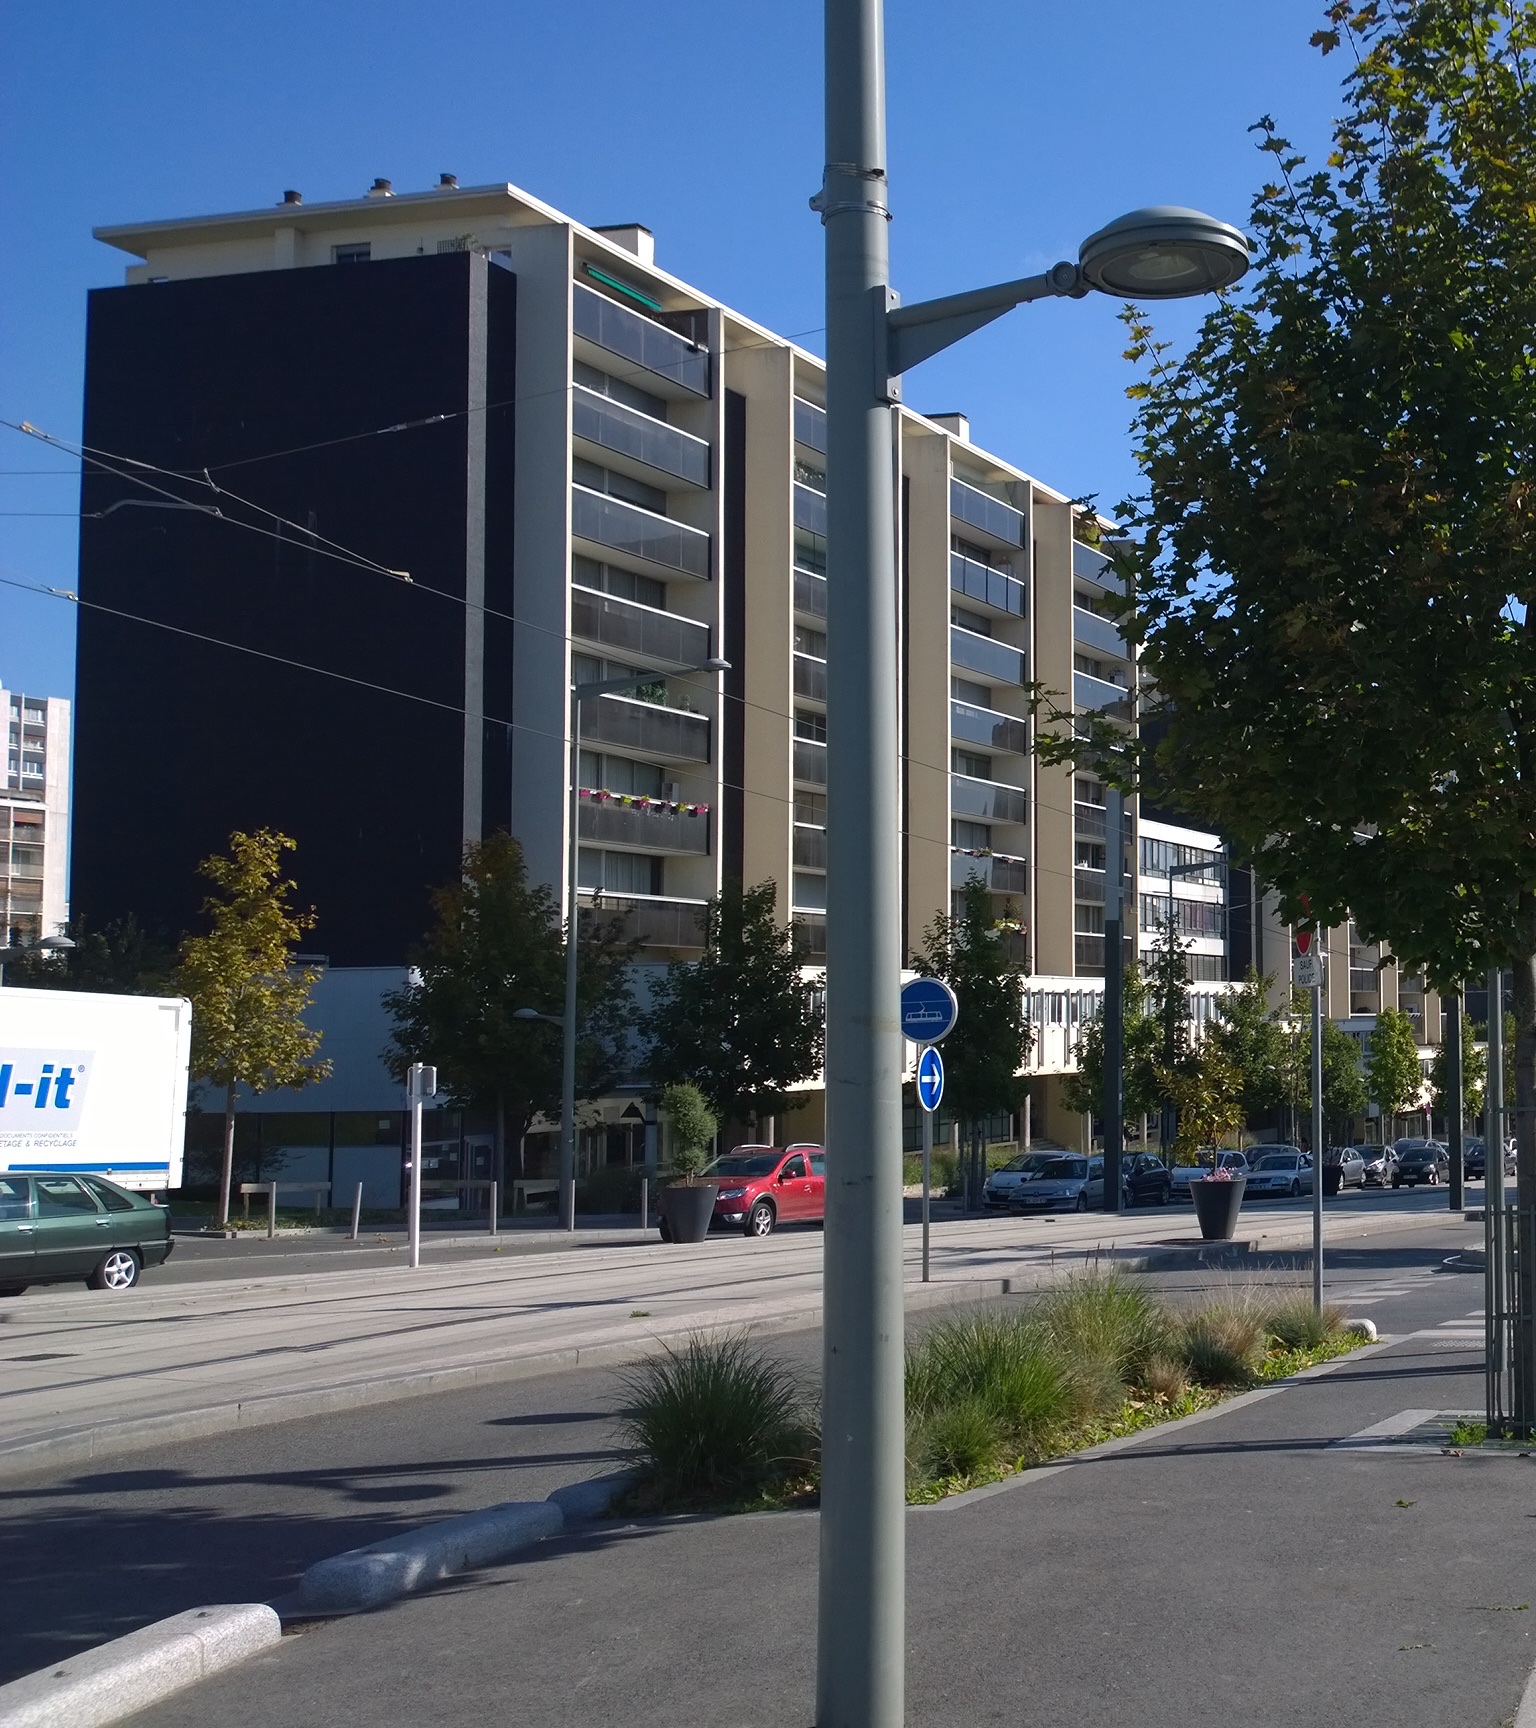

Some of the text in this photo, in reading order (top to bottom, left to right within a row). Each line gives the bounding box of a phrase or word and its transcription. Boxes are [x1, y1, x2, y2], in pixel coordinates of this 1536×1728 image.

[1300, 959, 1312, 970] SAUF
[1298, 973, 1316, 984] POLICE
[25, 1140, 31, 1148] &
